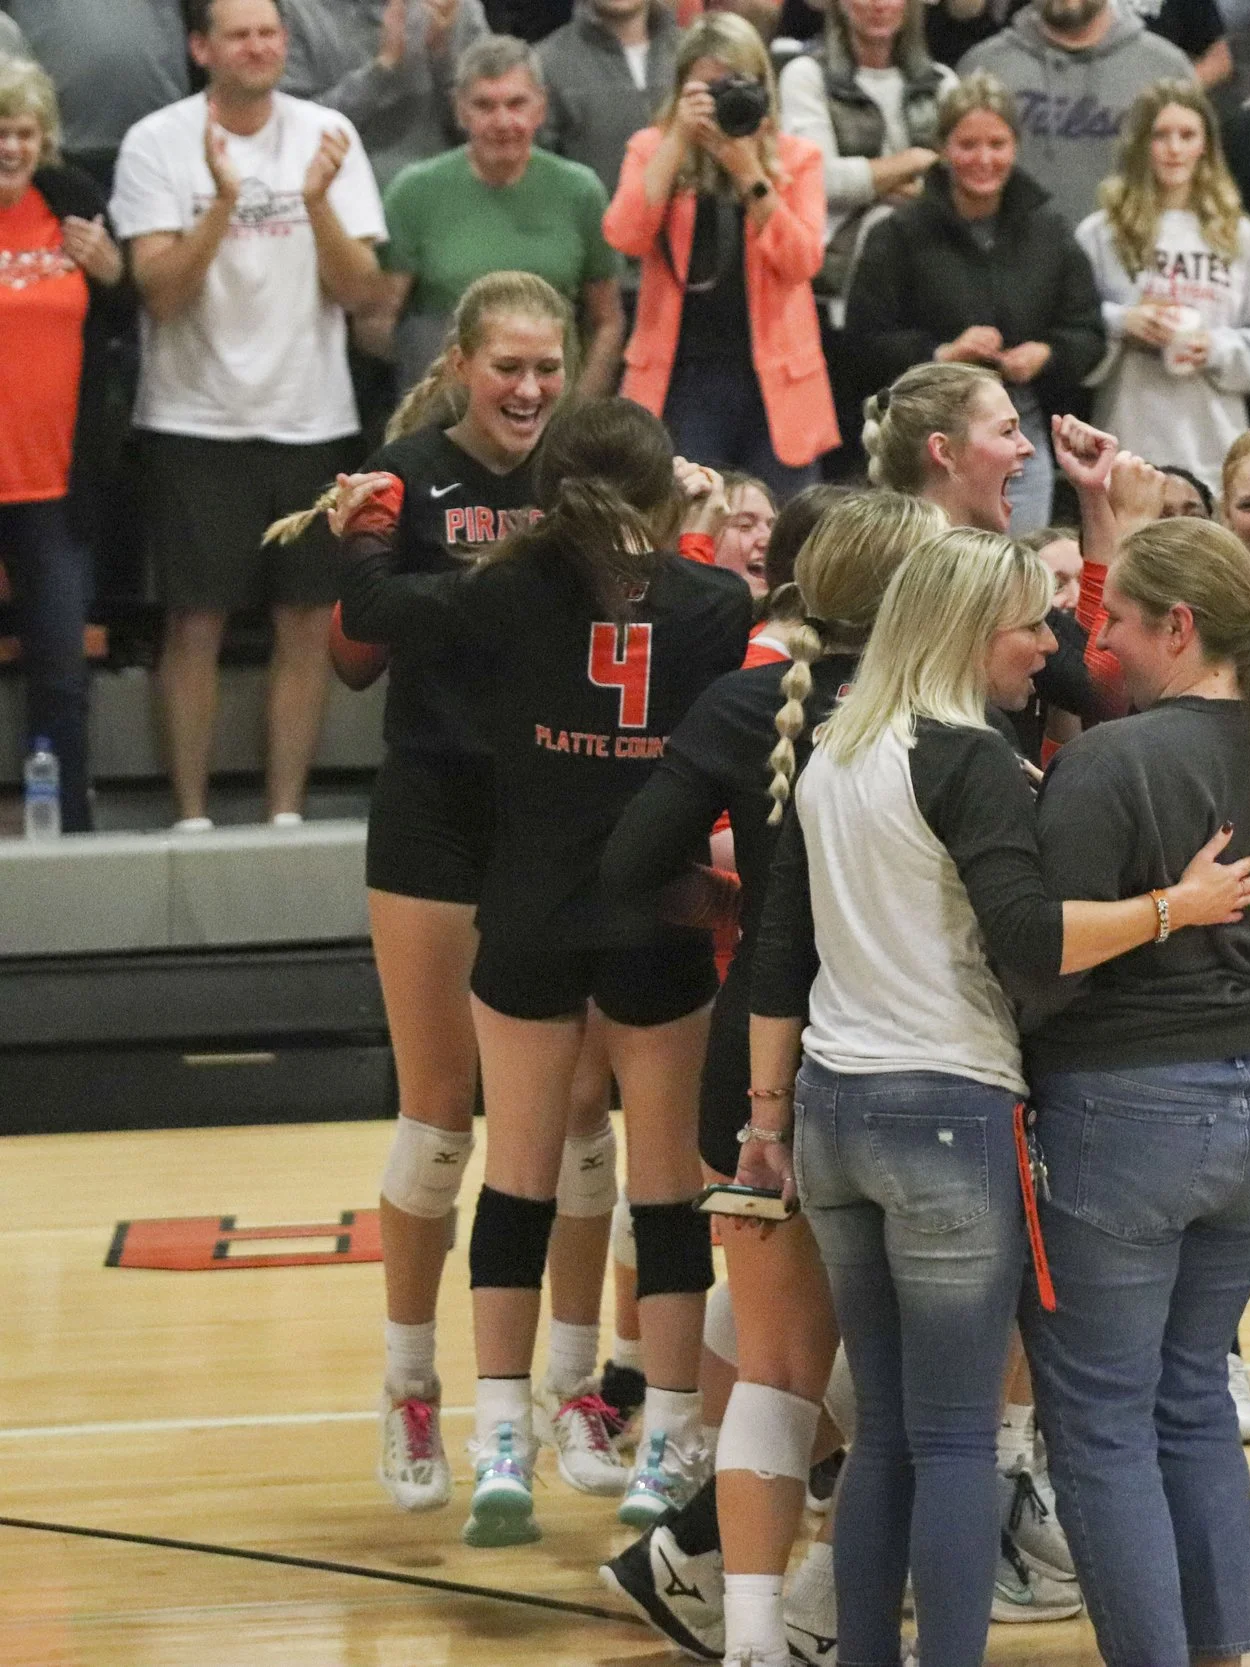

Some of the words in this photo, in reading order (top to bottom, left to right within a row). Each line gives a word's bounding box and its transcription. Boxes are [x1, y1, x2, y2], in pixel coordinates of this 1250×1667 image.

[588, 622, 652, 728] 4
[535, 724, 610, 757] PLATTE
[615, 735, 671, 758] COUN
